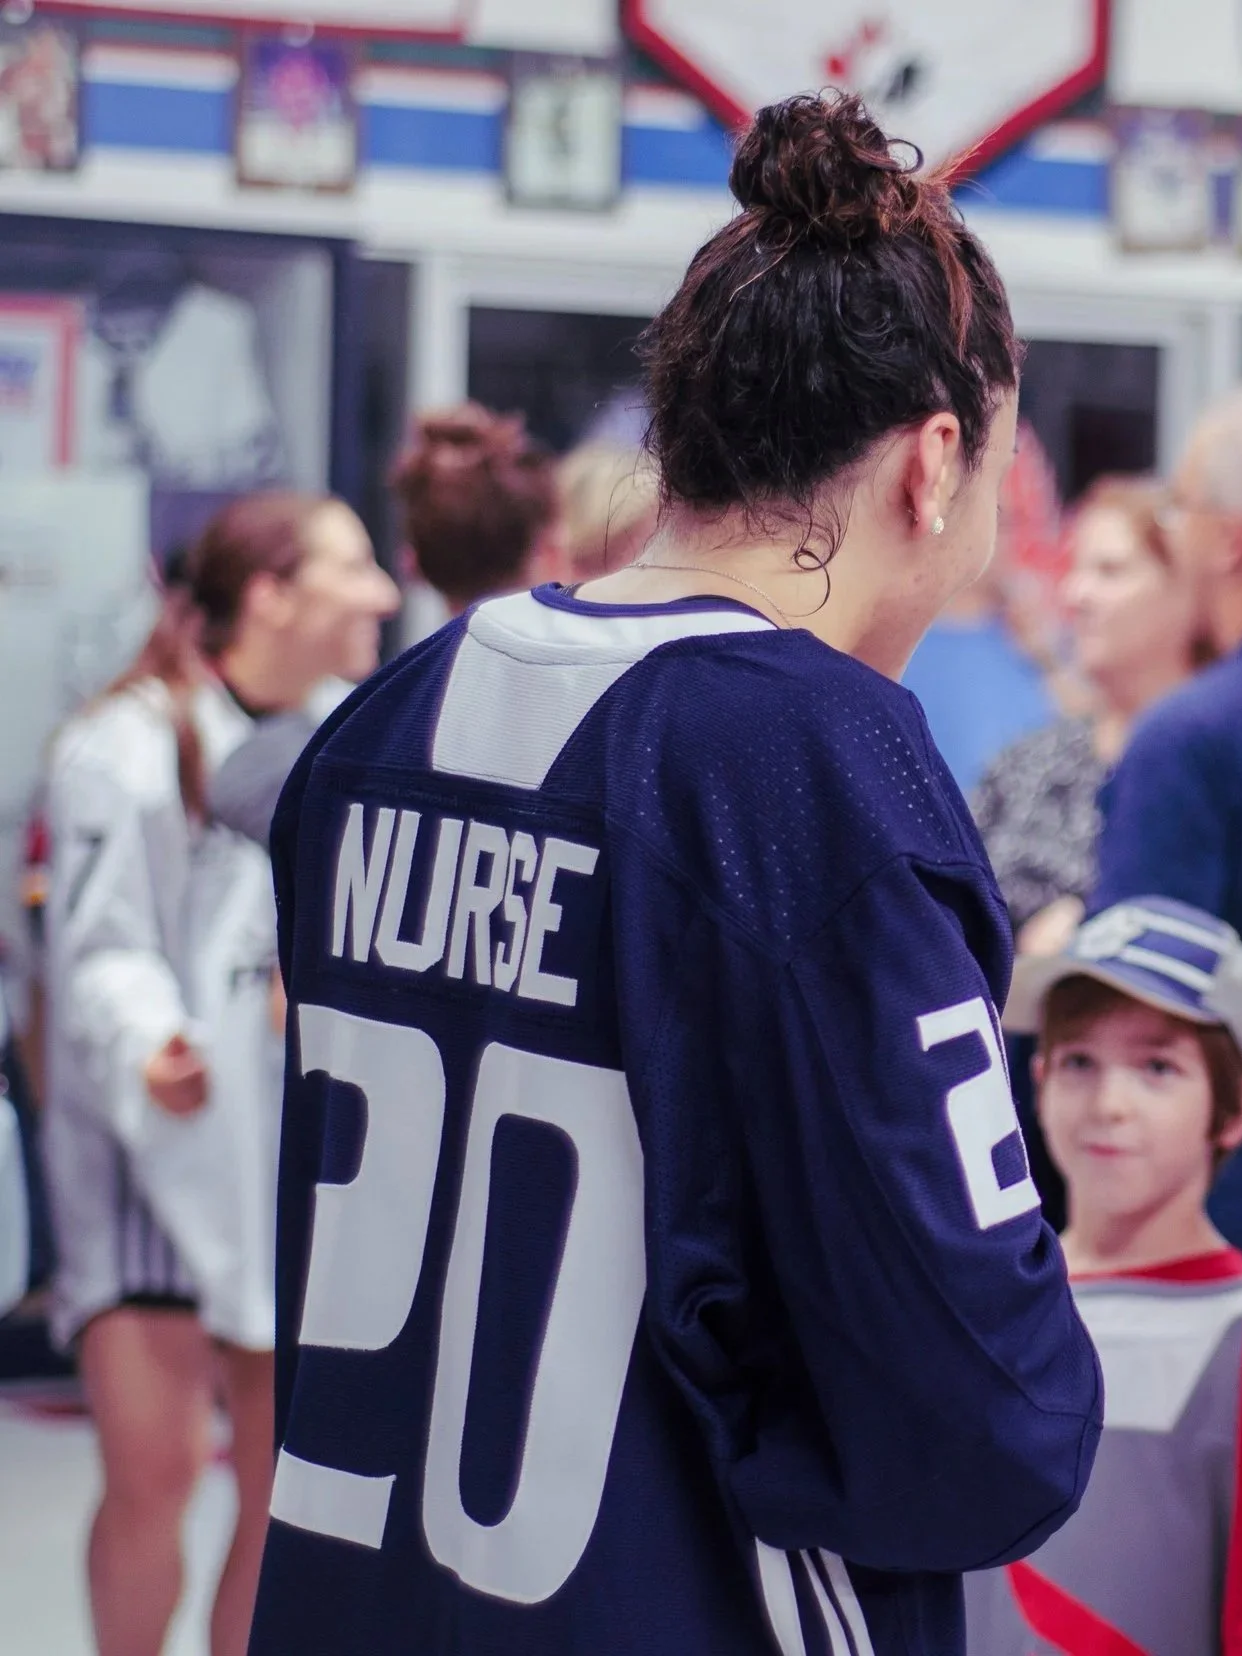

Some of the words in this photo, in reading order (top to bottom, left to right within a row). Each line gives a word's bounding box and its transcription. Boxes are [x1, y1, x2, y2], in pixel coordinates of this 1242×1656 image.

[332, 802, 600, 1006] NURSE
[916, 996, 1042, 1230] 2
[268, 1003, 647, 1606] 20
